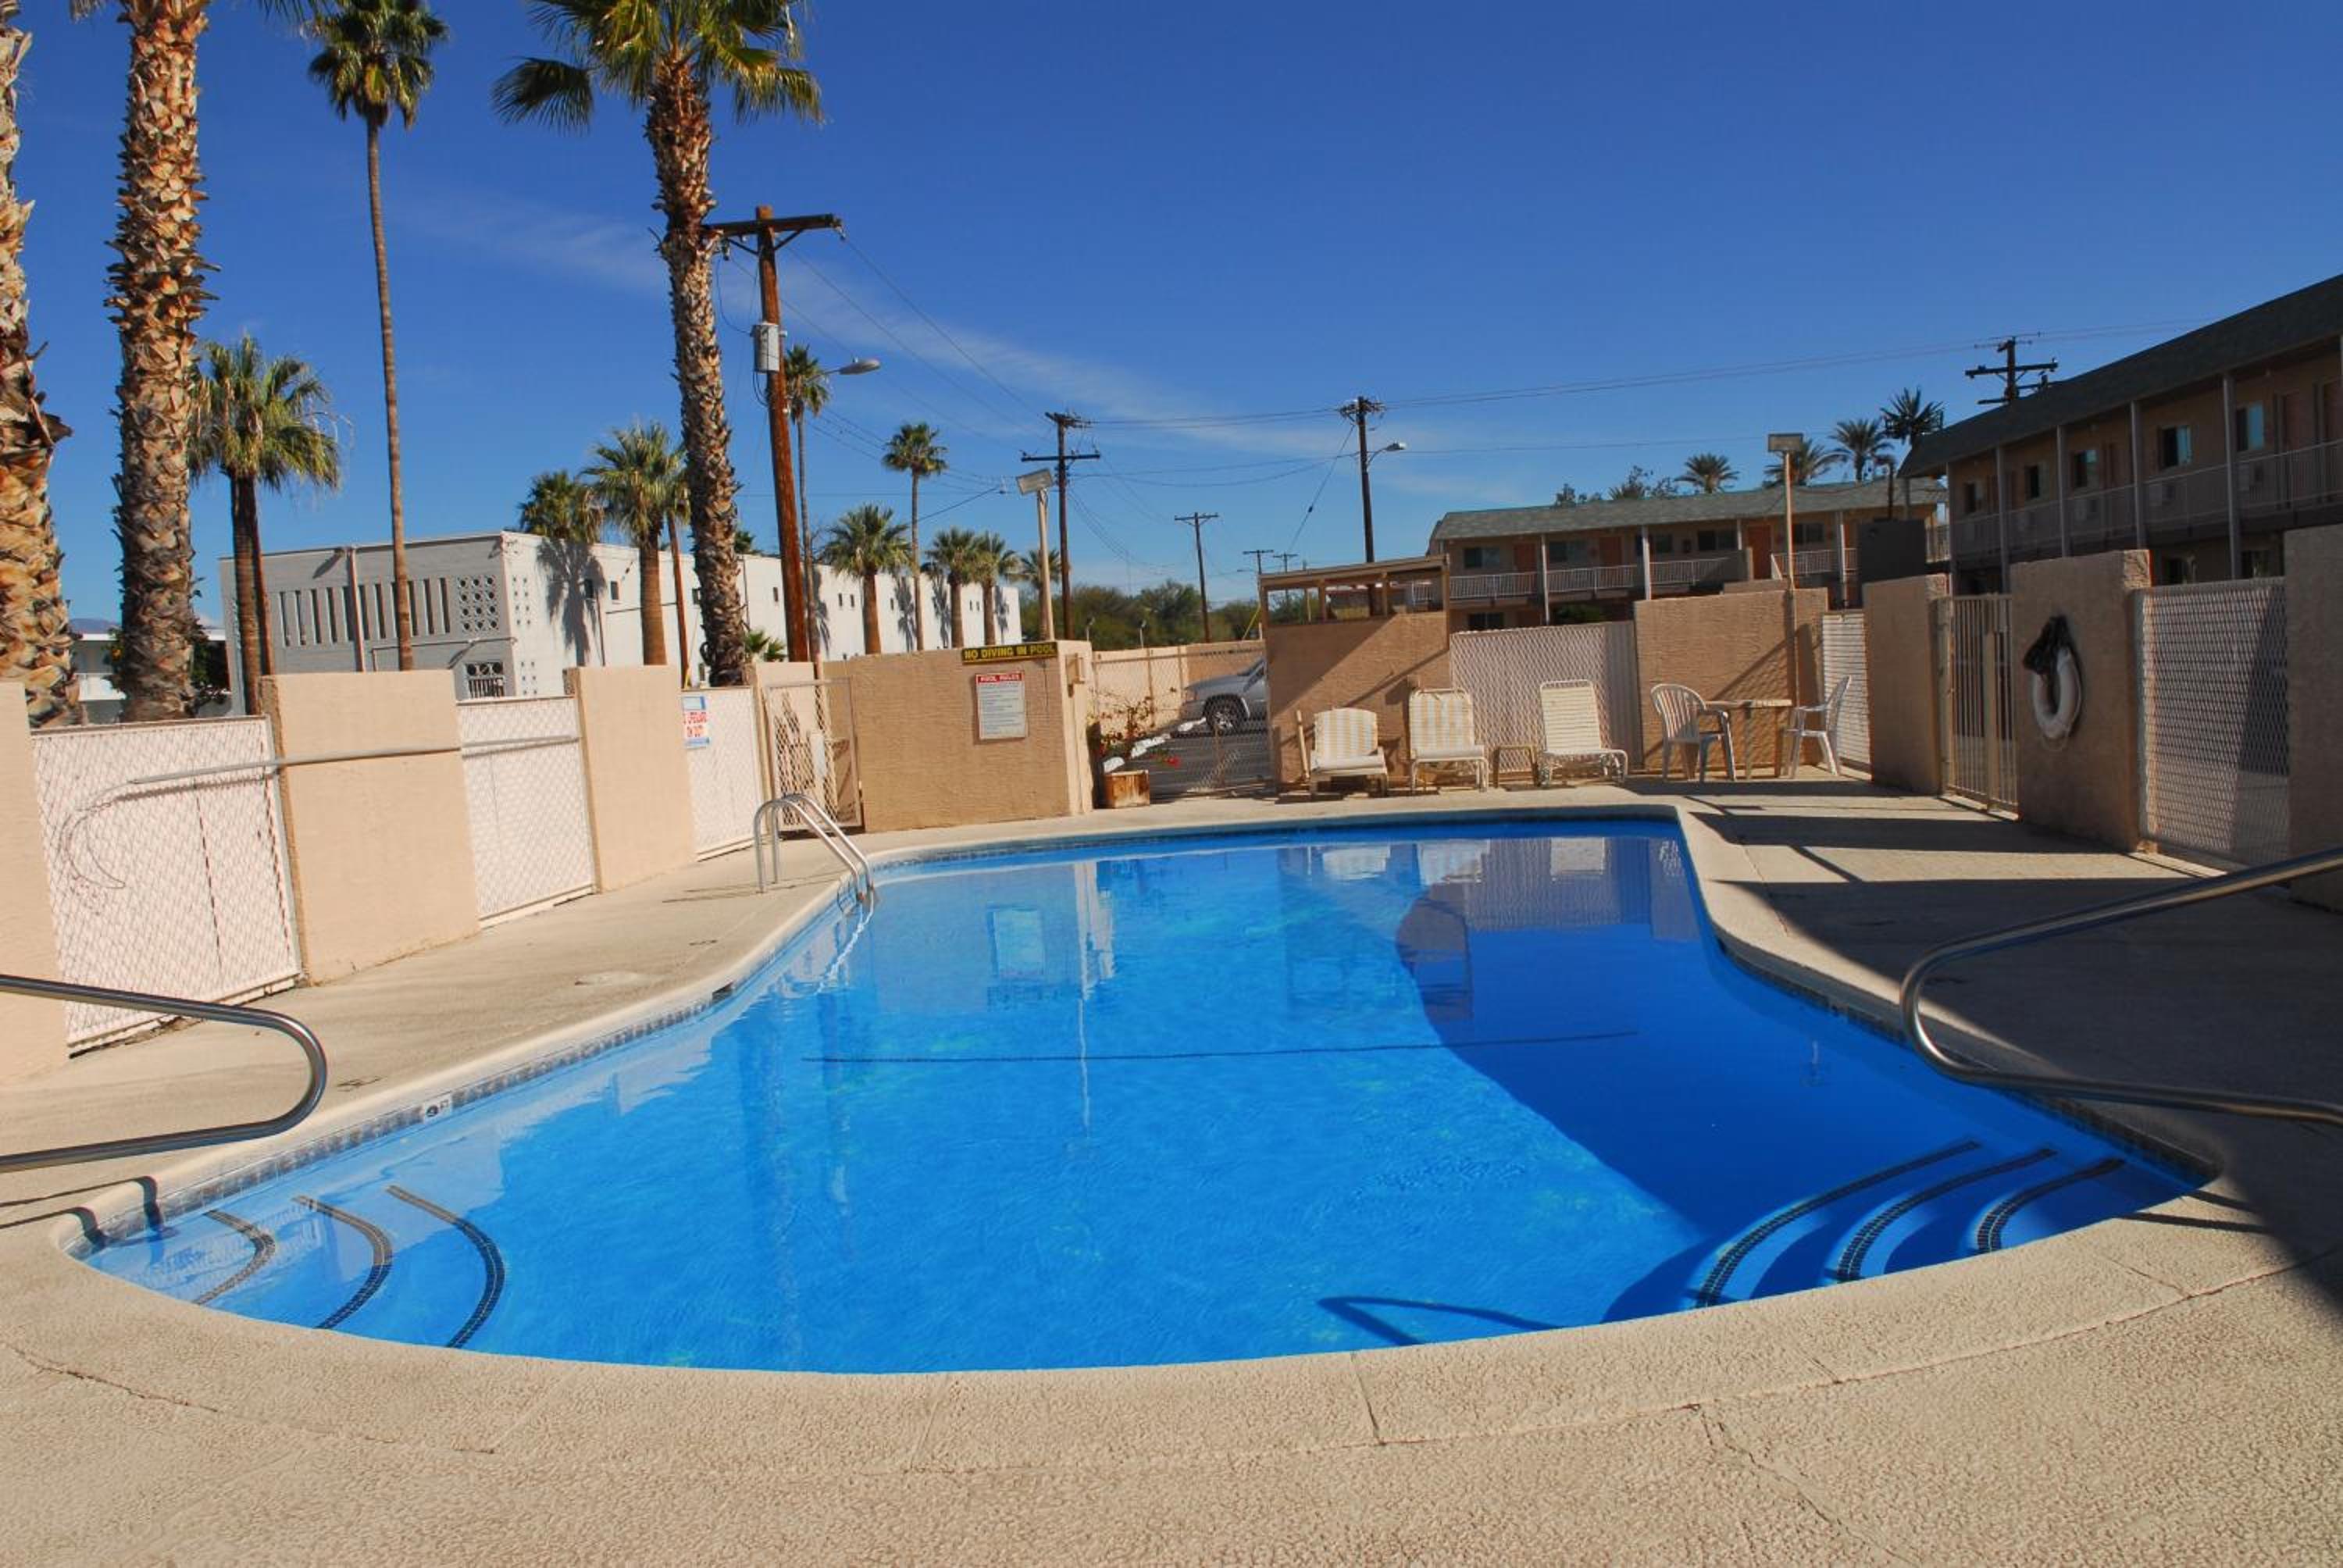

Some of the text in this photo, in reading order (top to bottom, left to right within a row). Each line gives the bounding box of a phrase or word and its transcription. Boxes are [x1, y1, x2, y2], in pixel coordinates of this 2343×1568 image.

[965, 644, 1054, 660] NO DIVING IN POOL
